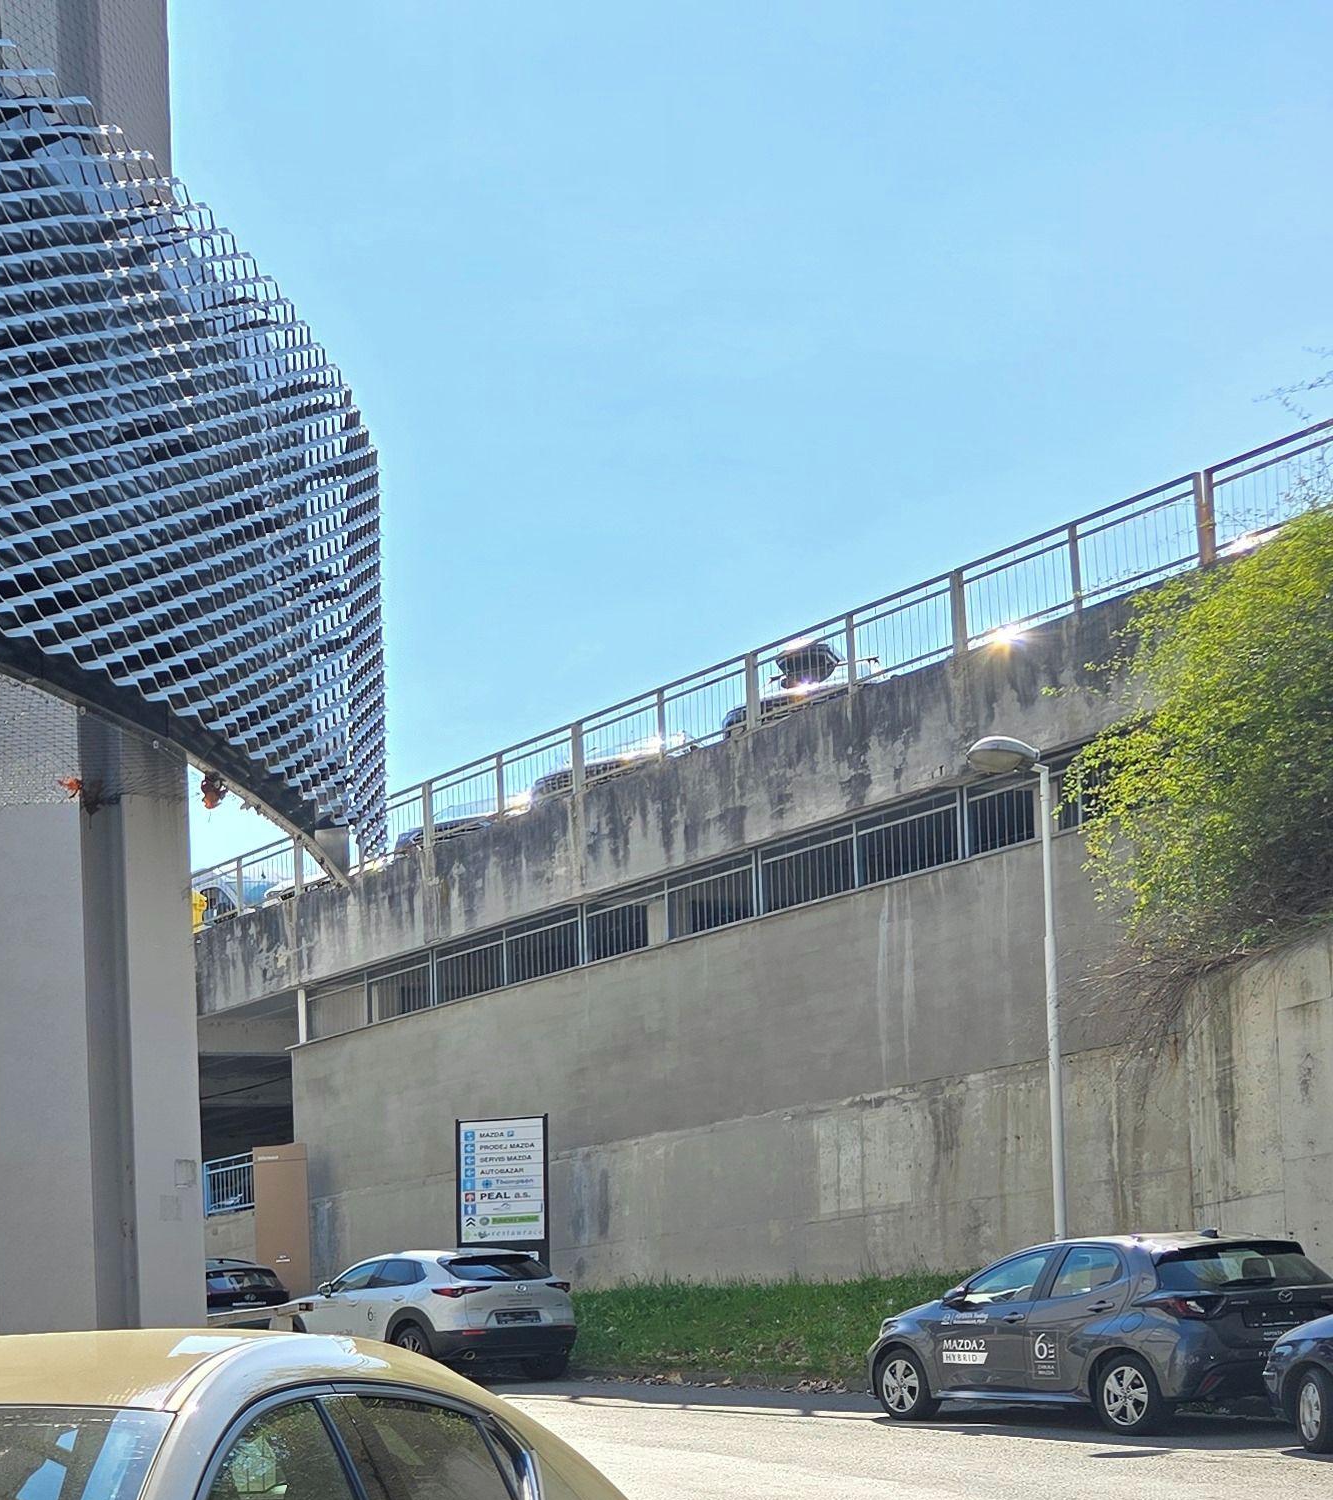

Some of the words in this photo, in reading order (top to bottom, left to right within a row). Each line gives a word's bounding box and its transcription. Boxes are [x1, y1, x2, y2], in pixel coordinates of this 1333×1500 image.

[480, 1167, 524, 1175] AUTOBAZAR
[480, 1191, 511, 1200] PEAL
[1034, 1333, 1047, 1359] 6
[945, 1353, 978, 1363] HYBRID
